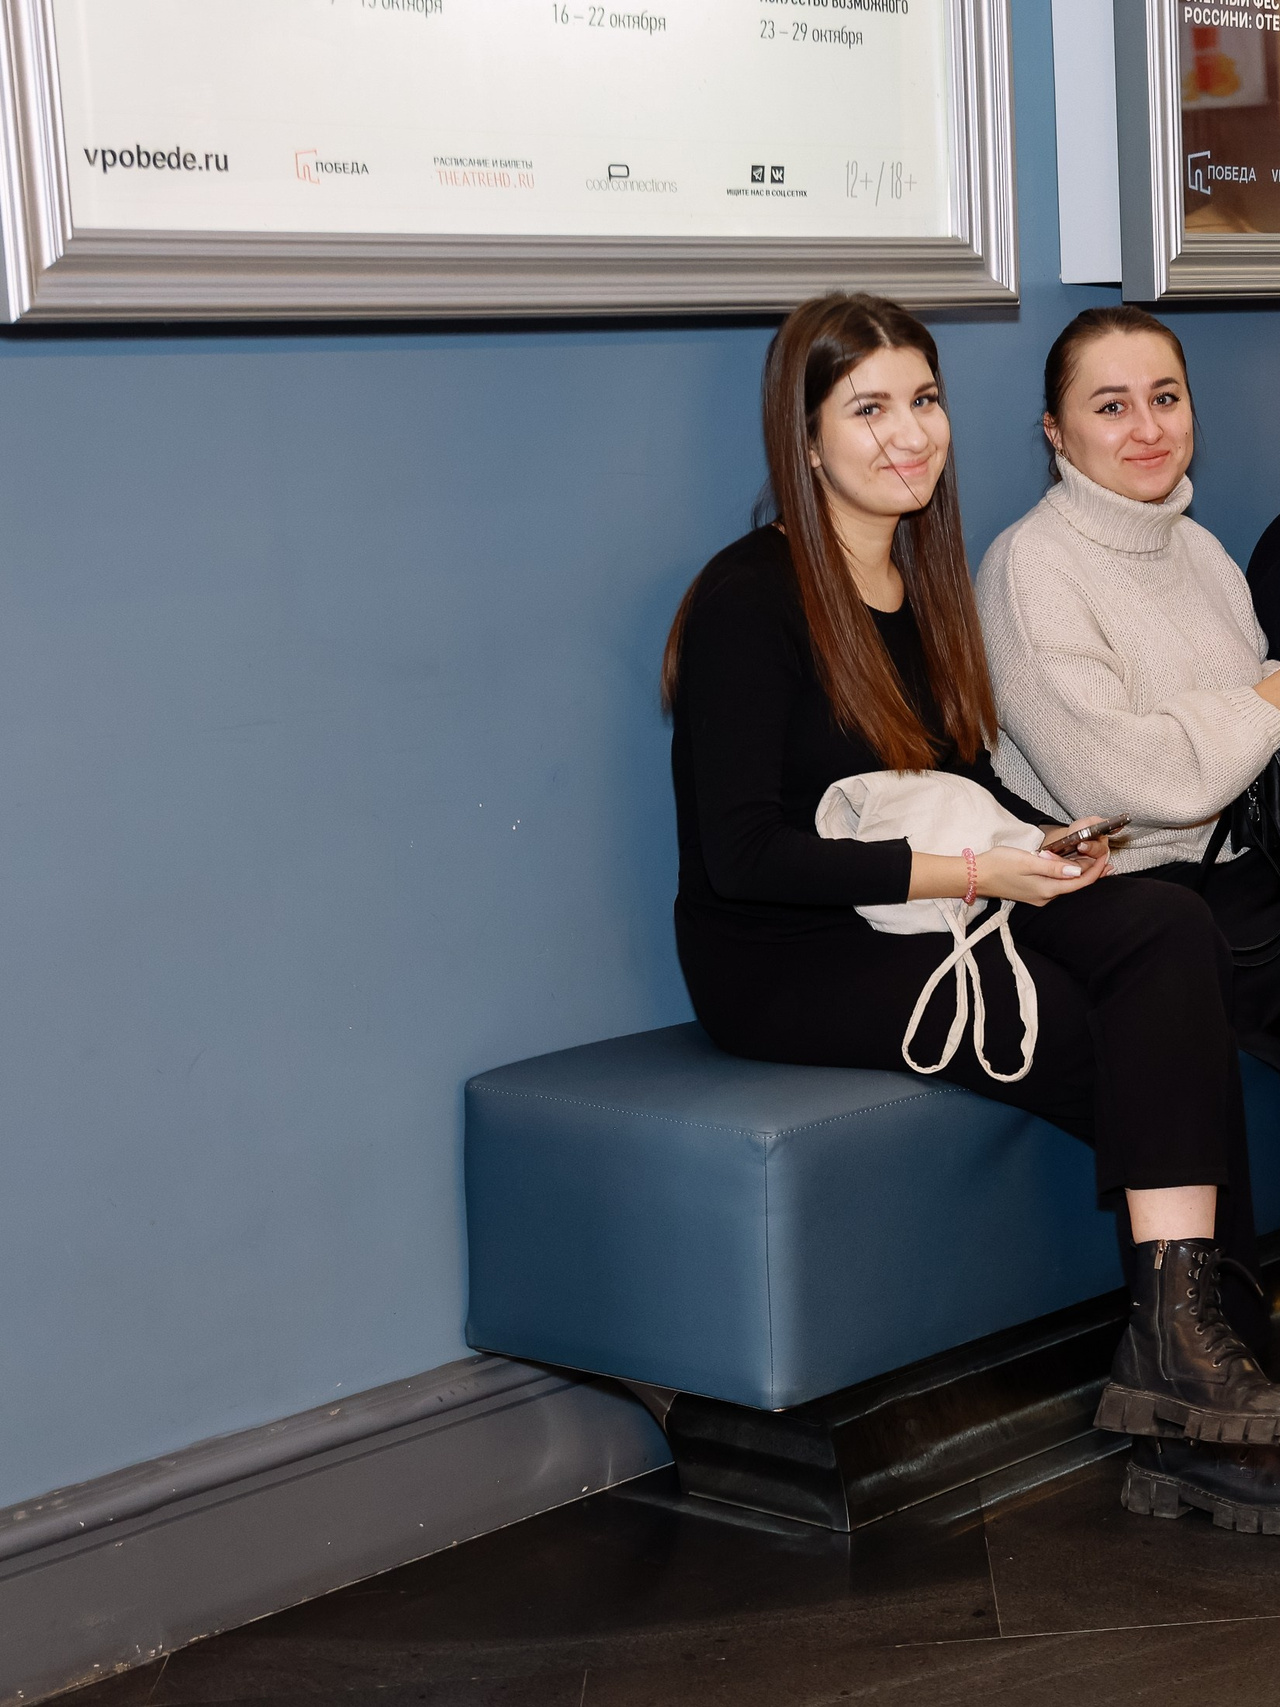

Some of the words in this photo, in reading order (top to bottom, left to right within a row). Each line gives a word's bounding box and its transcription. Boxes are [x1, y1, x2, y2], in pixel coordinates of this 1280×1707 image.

[553, 4, 569, 24] 16
[588, 6, 605, 27] 22
[609, 10, 666, 36] октября
[1184, 6, 1252, 28] РОССИНИ:
[760, 19, 775, 40] 23
[792, 22, 808, 42] 29
[812, 25, 863, 49] октября
[84, 144, 229, 174] vpobede.ru
[315, 160, 369, 175] ПОБЕДА
[433, 157, 490, 168] РАСПИСАНИЕ
[492, 159, 498, 168] И
[499, 159, 533, 169] БИЛЕТЫ
[1207, 165, 1257, 184] ПОБЕДА
[726, 189, 749, 197] ИЩИТЕ
